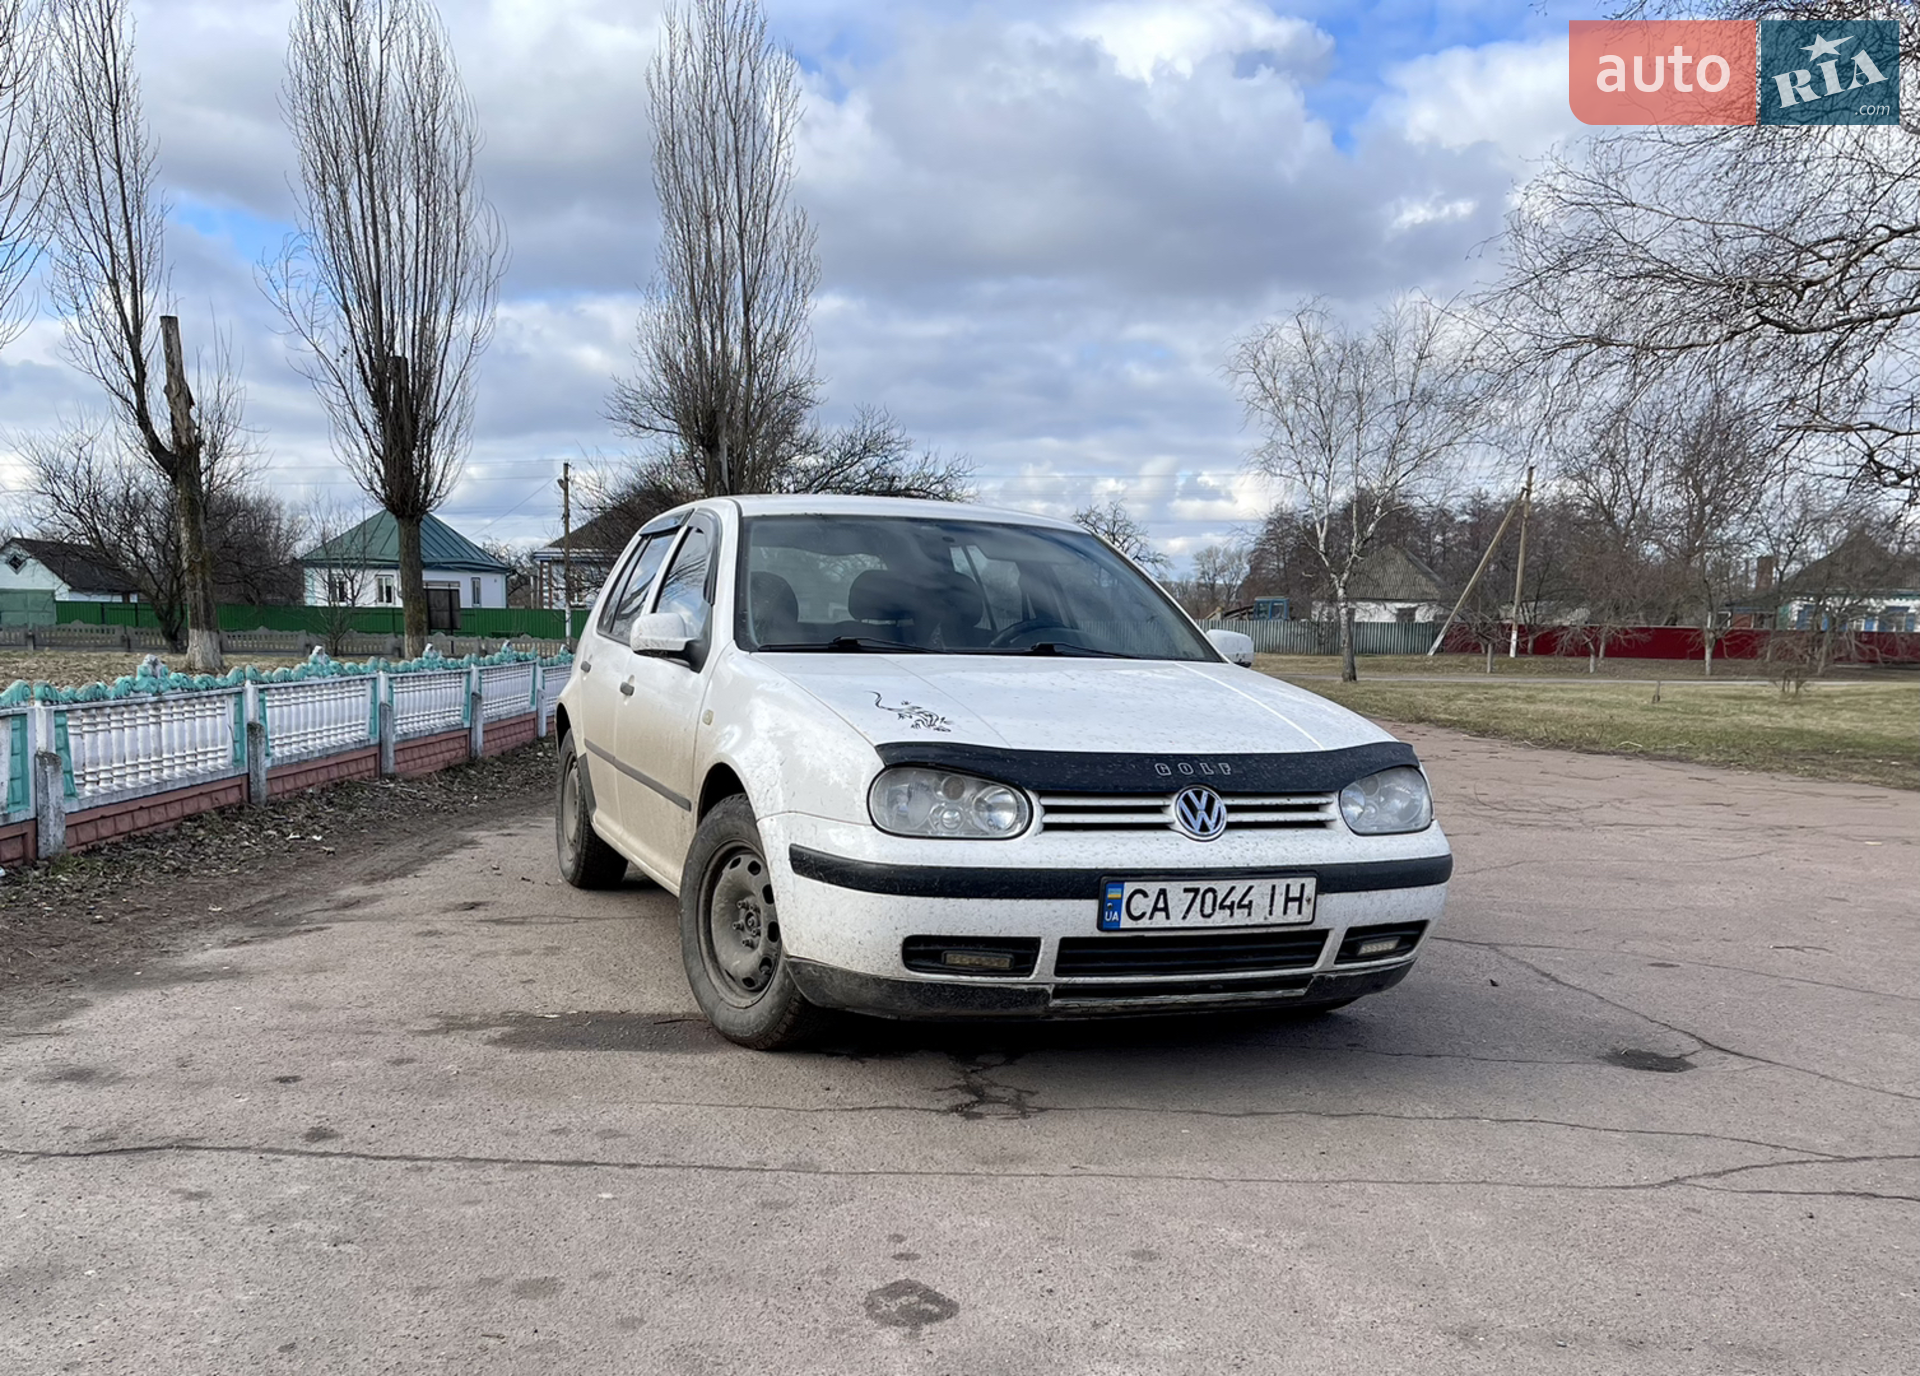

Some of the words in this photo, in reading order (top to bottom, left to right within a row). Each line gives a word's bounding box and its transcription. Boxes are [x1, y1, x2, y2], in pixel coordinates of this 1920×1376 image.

[1154, 762, 1232, 776] GOLF
[1125, 887, 1171, 921] CA
[1181, 885, 1255, 920] 7044
[1268, 882, 1306, 917] IH
[1104, 911, 1120, 922] UA
